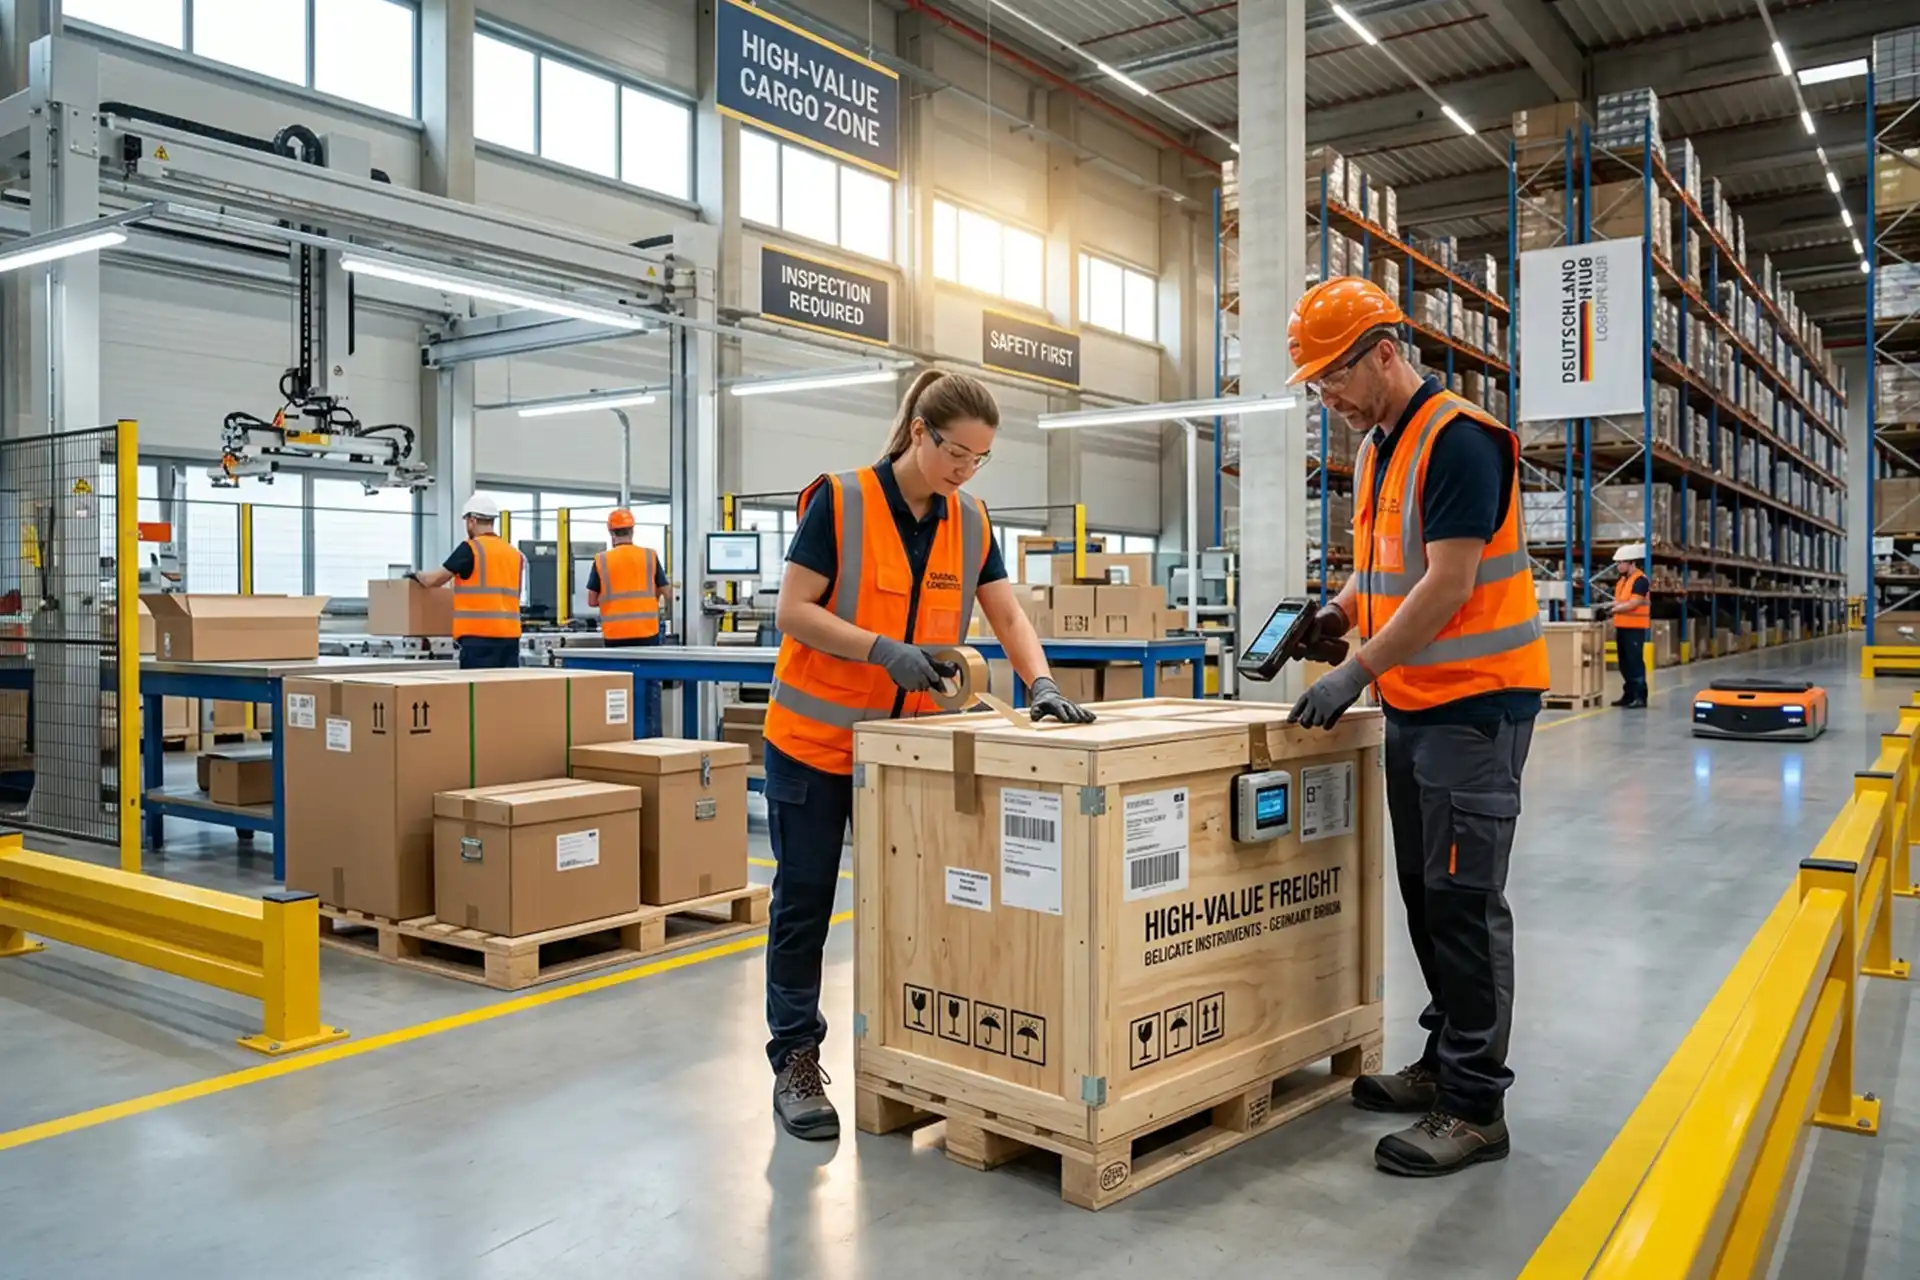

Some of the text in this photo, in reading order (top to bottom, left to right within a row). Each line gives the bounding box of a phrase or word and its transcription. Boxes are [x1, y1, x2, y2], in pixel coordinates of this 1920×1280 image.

[742, 28, 880, 115] HIGH-VALUE
[740, 67, 881, 148] CARGO ZONE
[781, 264, 872, 305] INSPECTION
[789, 290, 865, 326] REQUIRED
[990, 329, 1074, 368] SAFETY FIRST
[1144, 884, 1265, 943] HIGH-VALUE
[1269, 866, 1342, 910] FREIGHT
